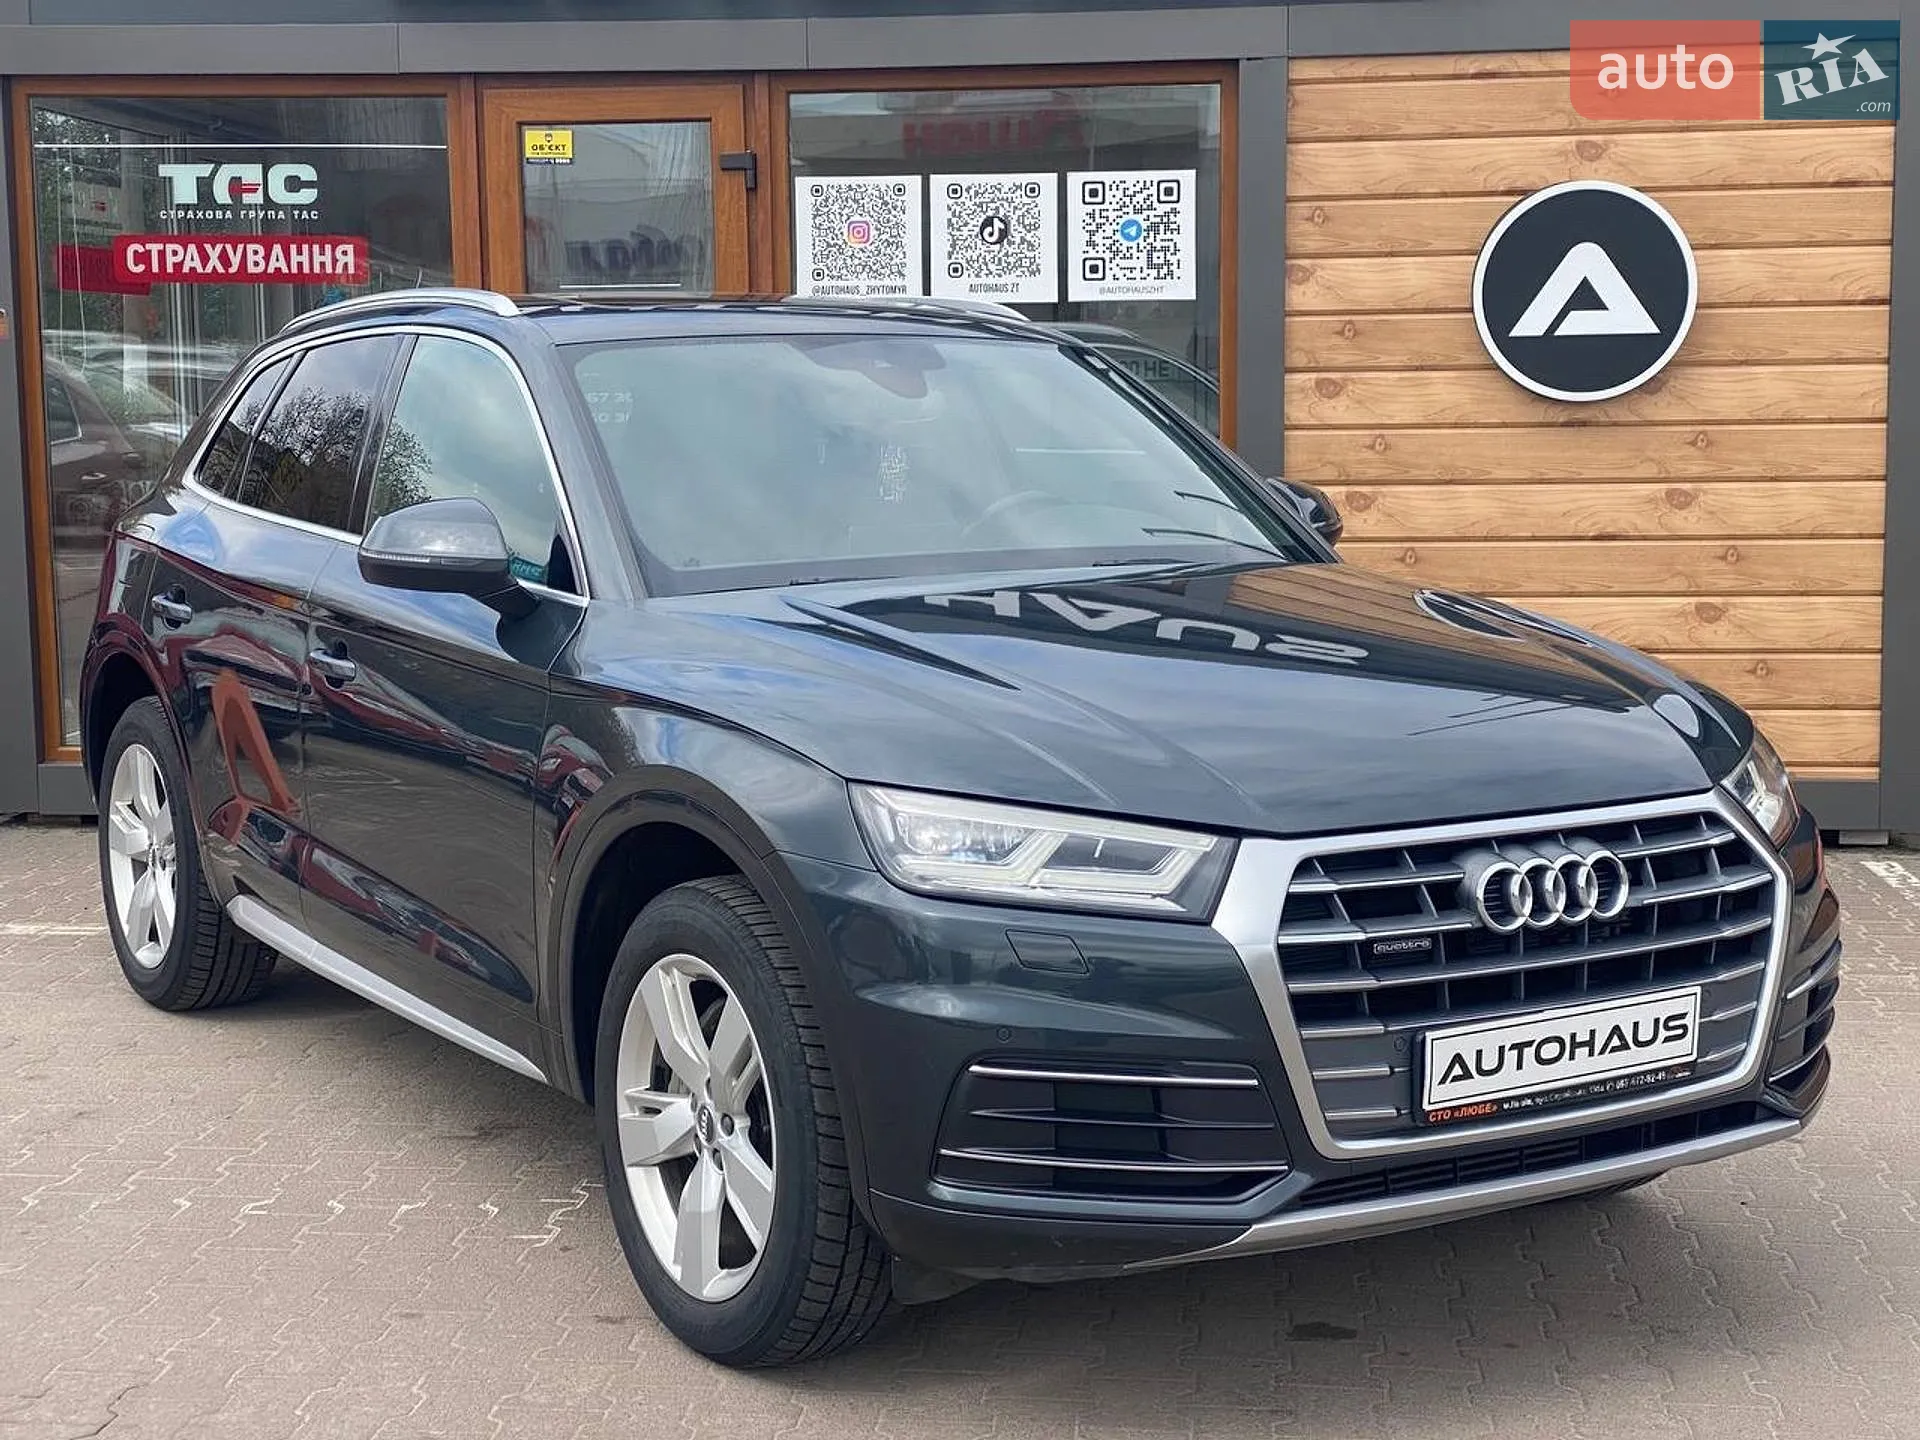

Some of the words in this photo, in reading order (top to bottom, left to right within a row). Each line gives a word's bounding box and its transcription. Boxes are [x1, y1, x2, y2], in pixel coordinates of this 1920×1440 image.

[160, 210, 232, 219] СТРАХОВА
[240, 210, 286, 219] ГРУПА
[293, 210, 319, 219] ТАС
[126, 243, 355, 274] СТРАХУВАННЯ
[968, 283, 1008, 292] AUTOHAUS
[1438, 1012, 1689, 1086] AUTOHAUS
